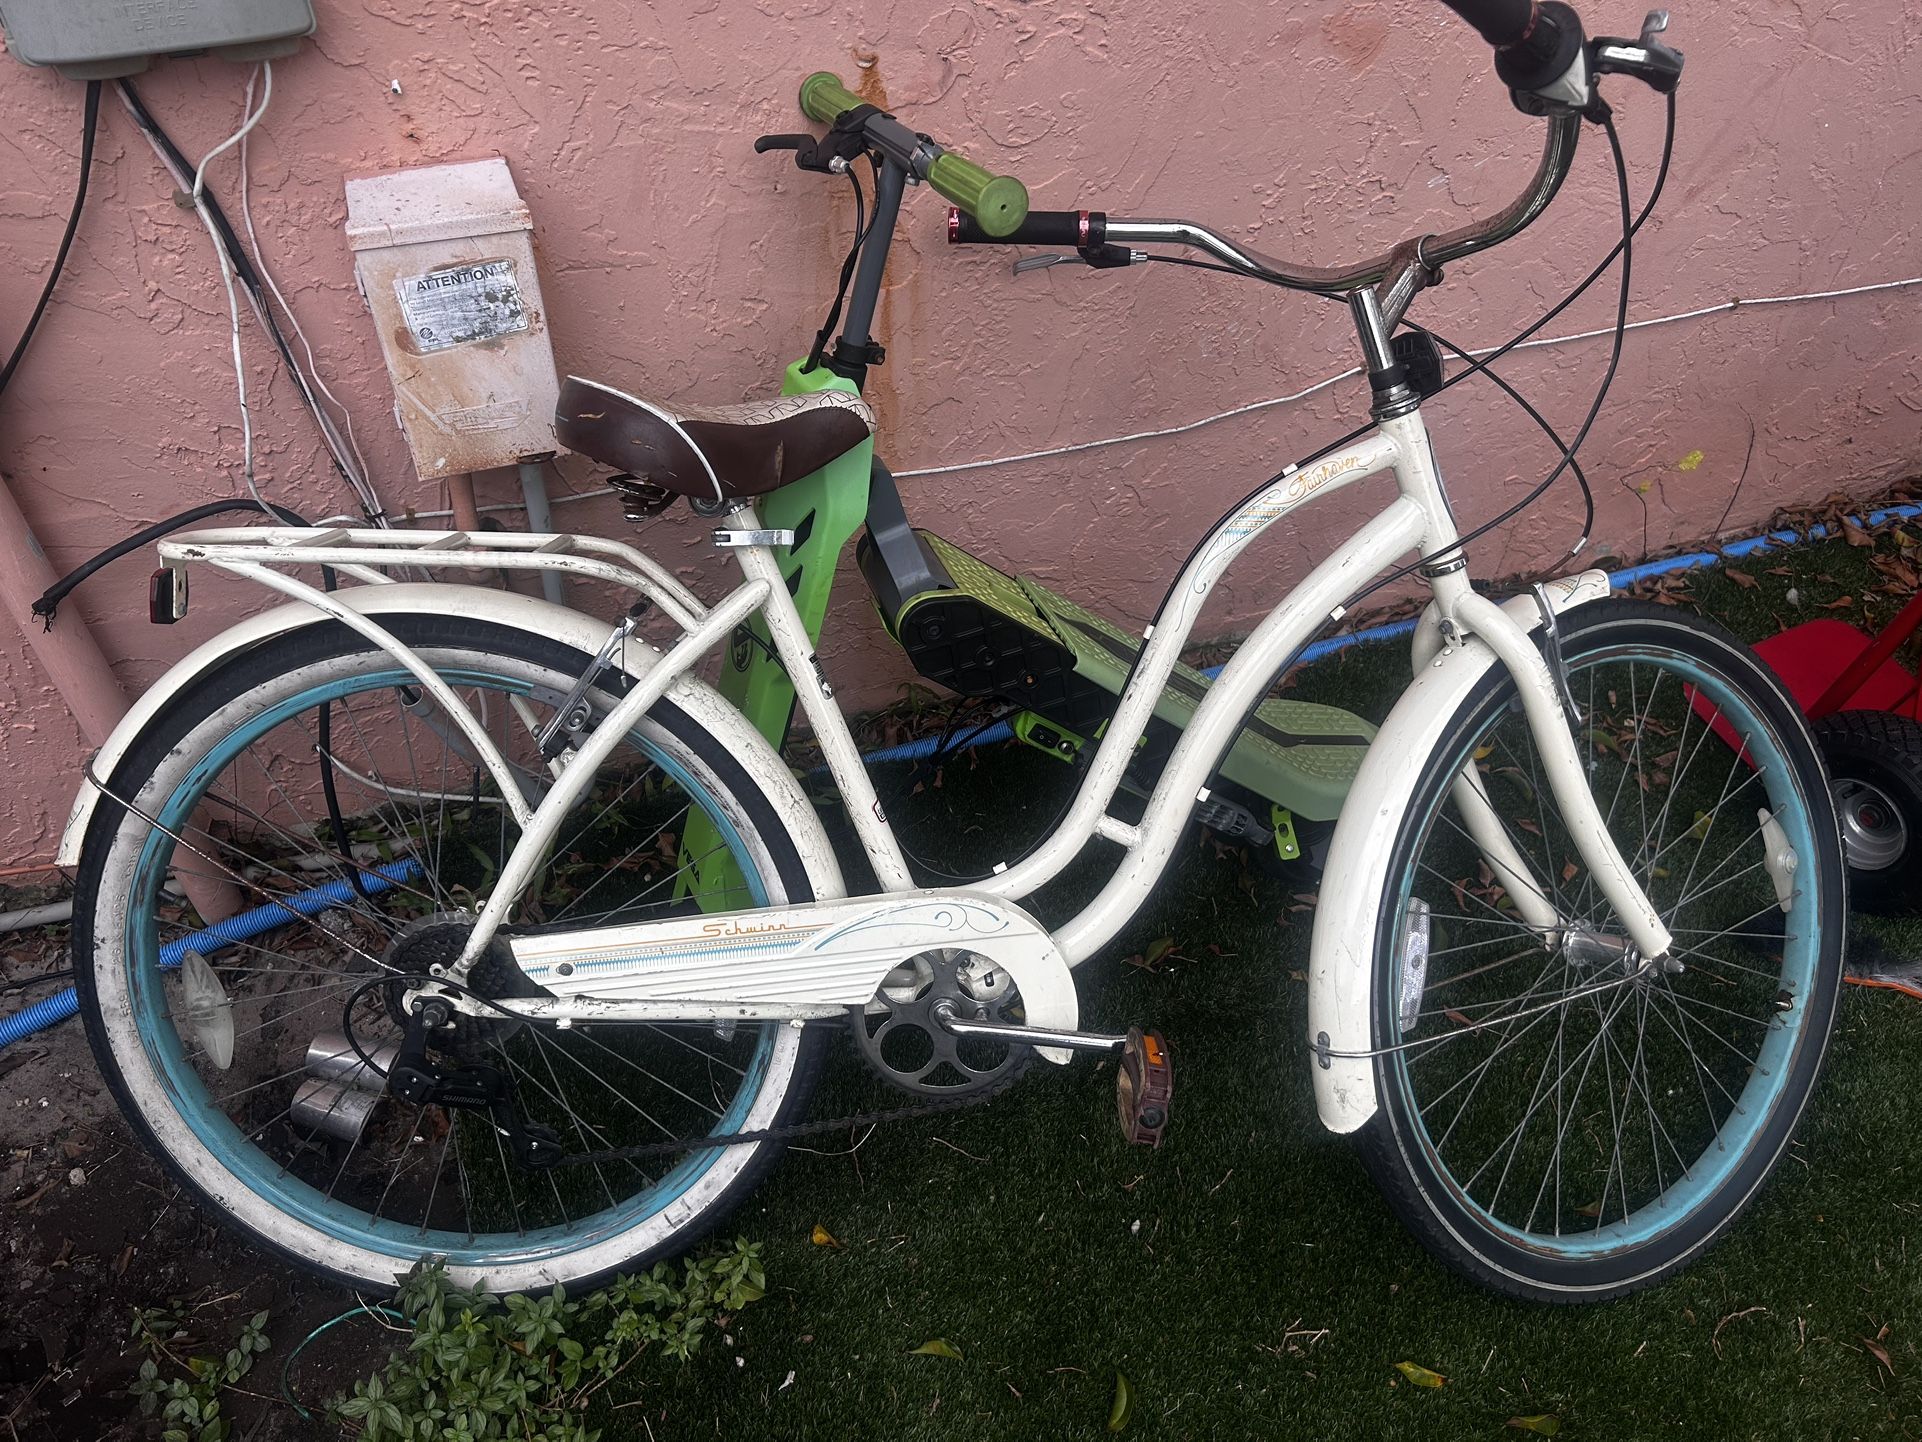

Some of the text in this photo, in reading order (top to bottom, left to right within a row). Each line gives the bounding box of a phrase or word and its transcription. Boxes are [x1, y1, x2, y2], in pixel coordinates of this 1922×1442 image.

[133, 14, 187, 31] DEVICE
[416, 267, 495, 292] ATTENTION
[1288, 456, 1370, 496] Fairhaven
[703, 920, 787, 936] Schwinn
[442, 1095, 487, 1105] SHIMANO
